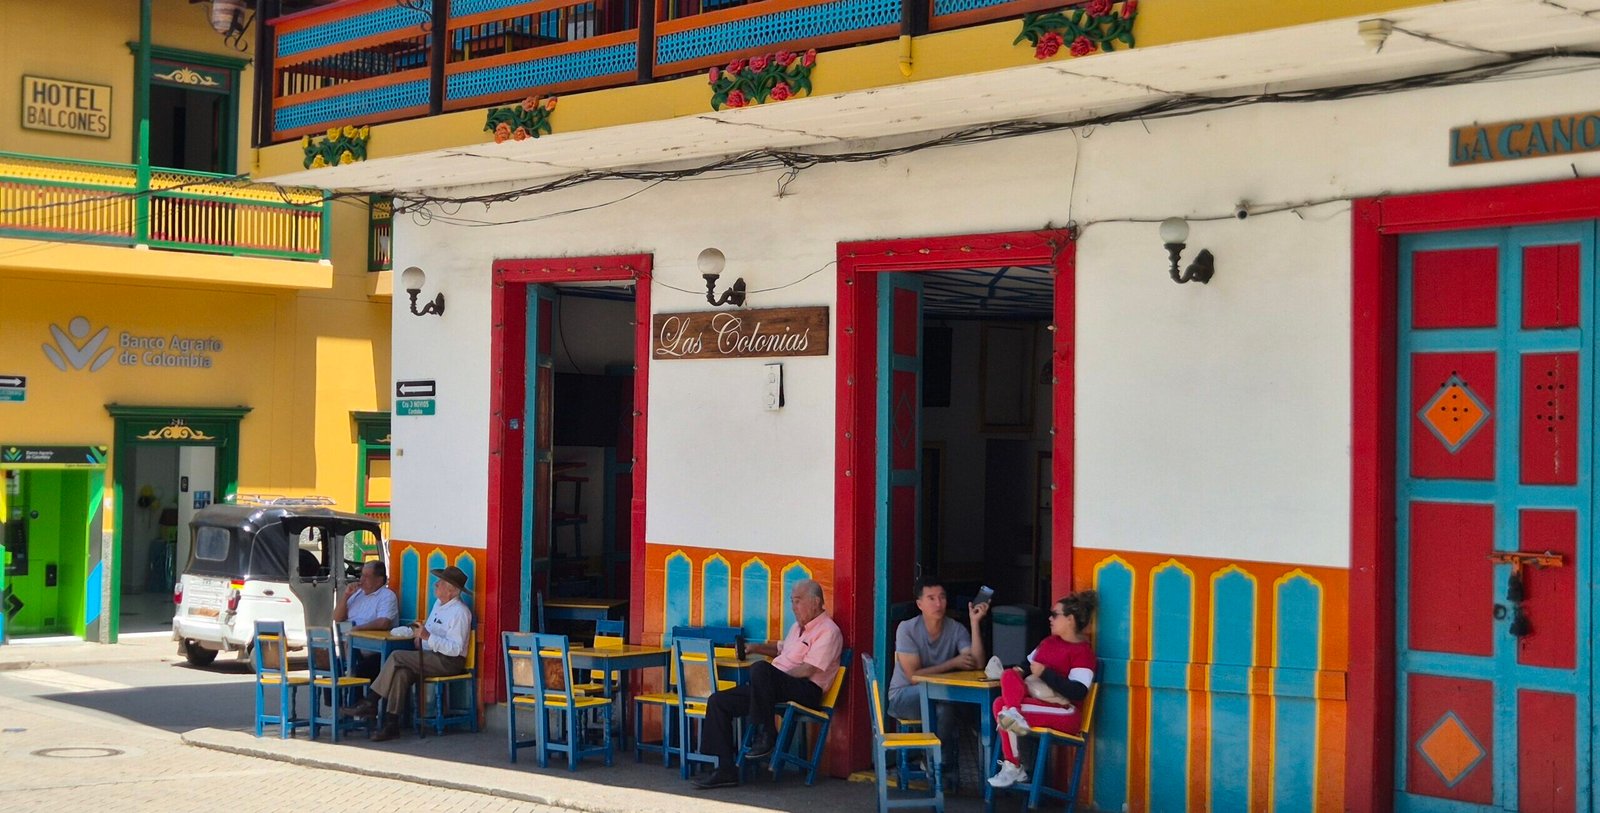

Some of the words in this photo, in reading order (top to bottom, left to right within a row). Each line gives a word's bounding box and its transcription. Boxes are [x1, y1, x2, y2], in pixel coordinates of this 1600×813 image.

[33, 81, 103, 112] HOTEL
[27, 106, 107, 133] BALCONES
[1449, 127, 1493, 163] LA
[120, 332, 165, 349] Banco
[170, 335, 223, 353] Agrario
[656, 316, 703, 357] Las
[712, 312, 810, 354] Colonias
[120, 351, 137, 365] de
[143, 351, 212, 368] Colombia
